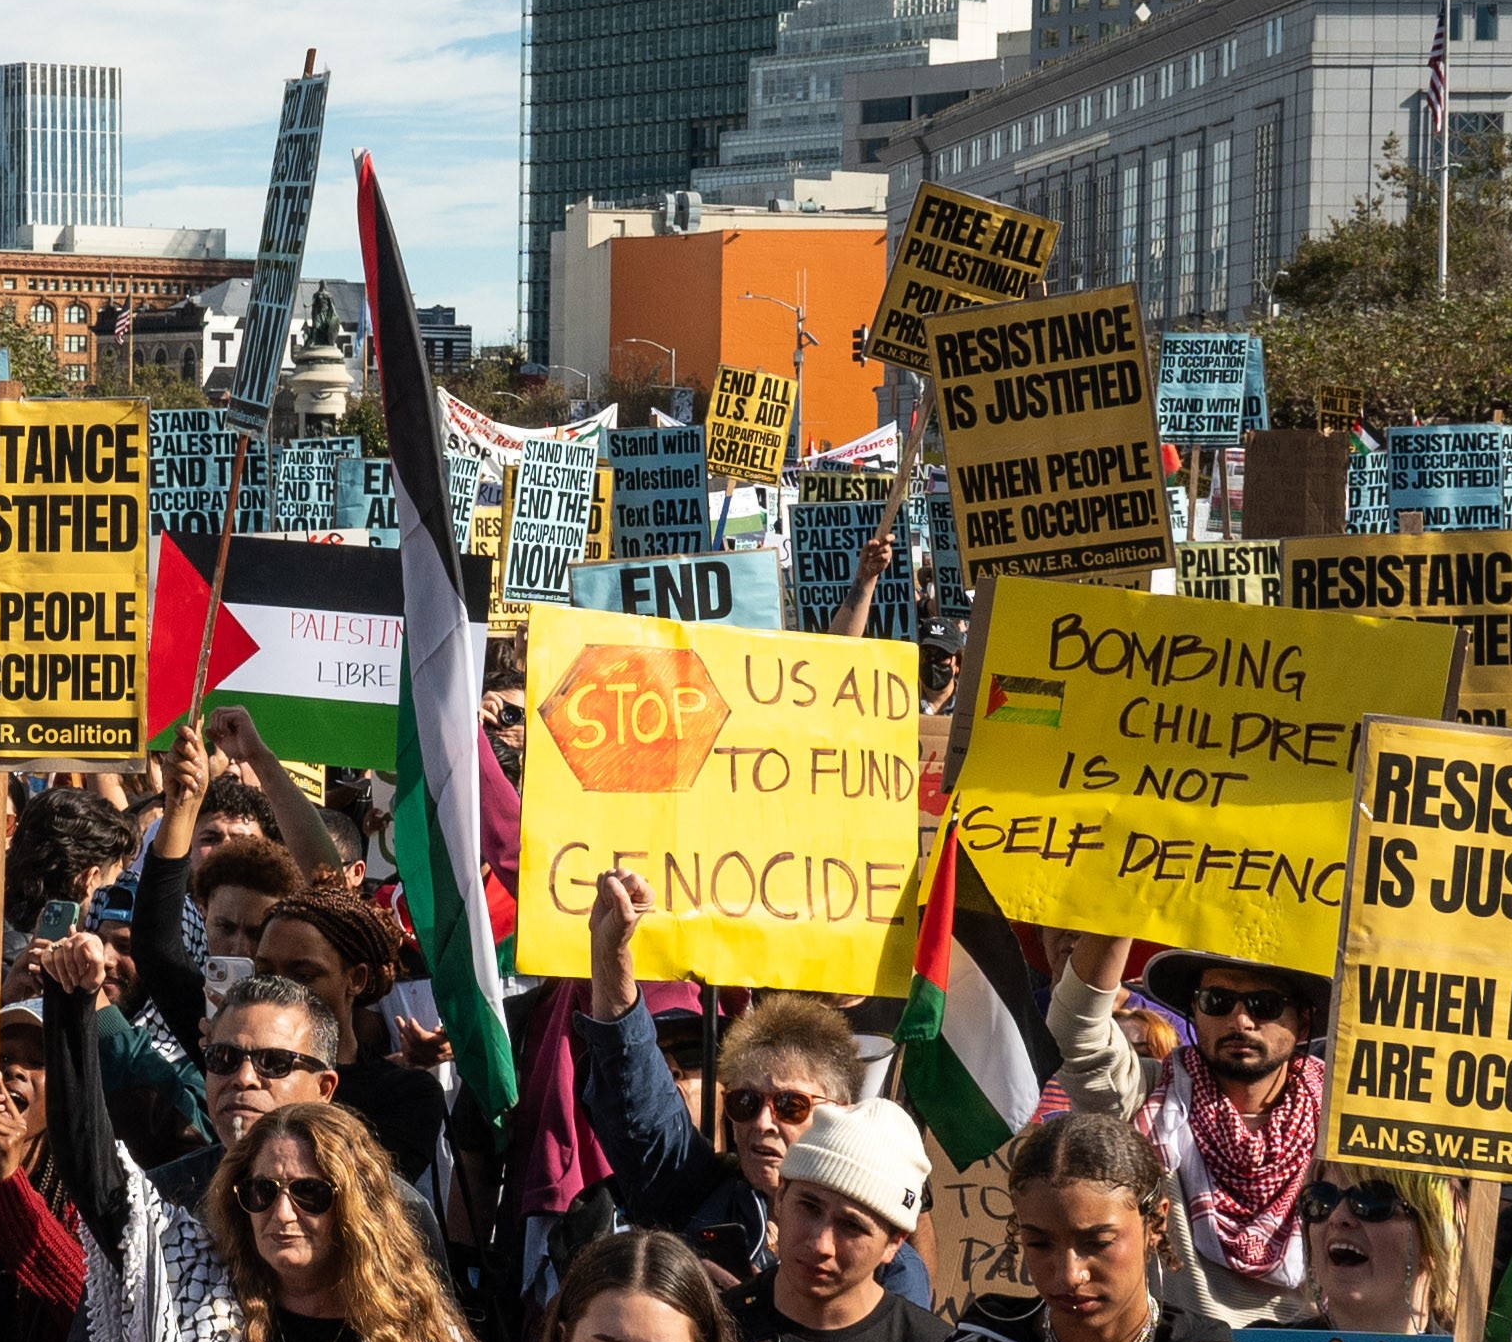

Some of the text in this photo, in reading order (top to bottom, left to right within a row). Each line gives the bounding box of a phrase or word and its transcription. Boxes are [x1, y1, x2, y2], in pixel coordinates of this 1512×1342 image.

[934, 303, 1135, 380] RESISTANCE
[942, 359, 1142, 432] IS JUSTIFIED
[522, 463, 592, 491] PALESTINE!
[525, 440, 594, 468] STAND WITH
[956, 441, 1151, 505] WHEN PEOPLE
[514, 521, 583, 547] OCCUPATION
[517, 489, 589, 524] END THE
[966, 488, 1160, 550] ARE OCCUPIED!
[977, 542, 1161, 580] A.N.S.W.E.R. Coalition
[1, 591, 136, 643] PEOPLE
[745, 654, 910, 720] US AID
[1049, 613, 1307, 701] BOMBING
[27, 723, 132, 746] Coalition
[566, 683, 706, 749] STOP
[714, 746, 914, 802] TO FUND
[1059, 752, 1249, 807] IS NOT
[962, 805, 1346, 906] SELF DEFENC
[1363, 836, 1418, 906] IS
[1357, 964, 1496, 1042] WHEN
[1347, 1040, 1435, 1104] ARE
